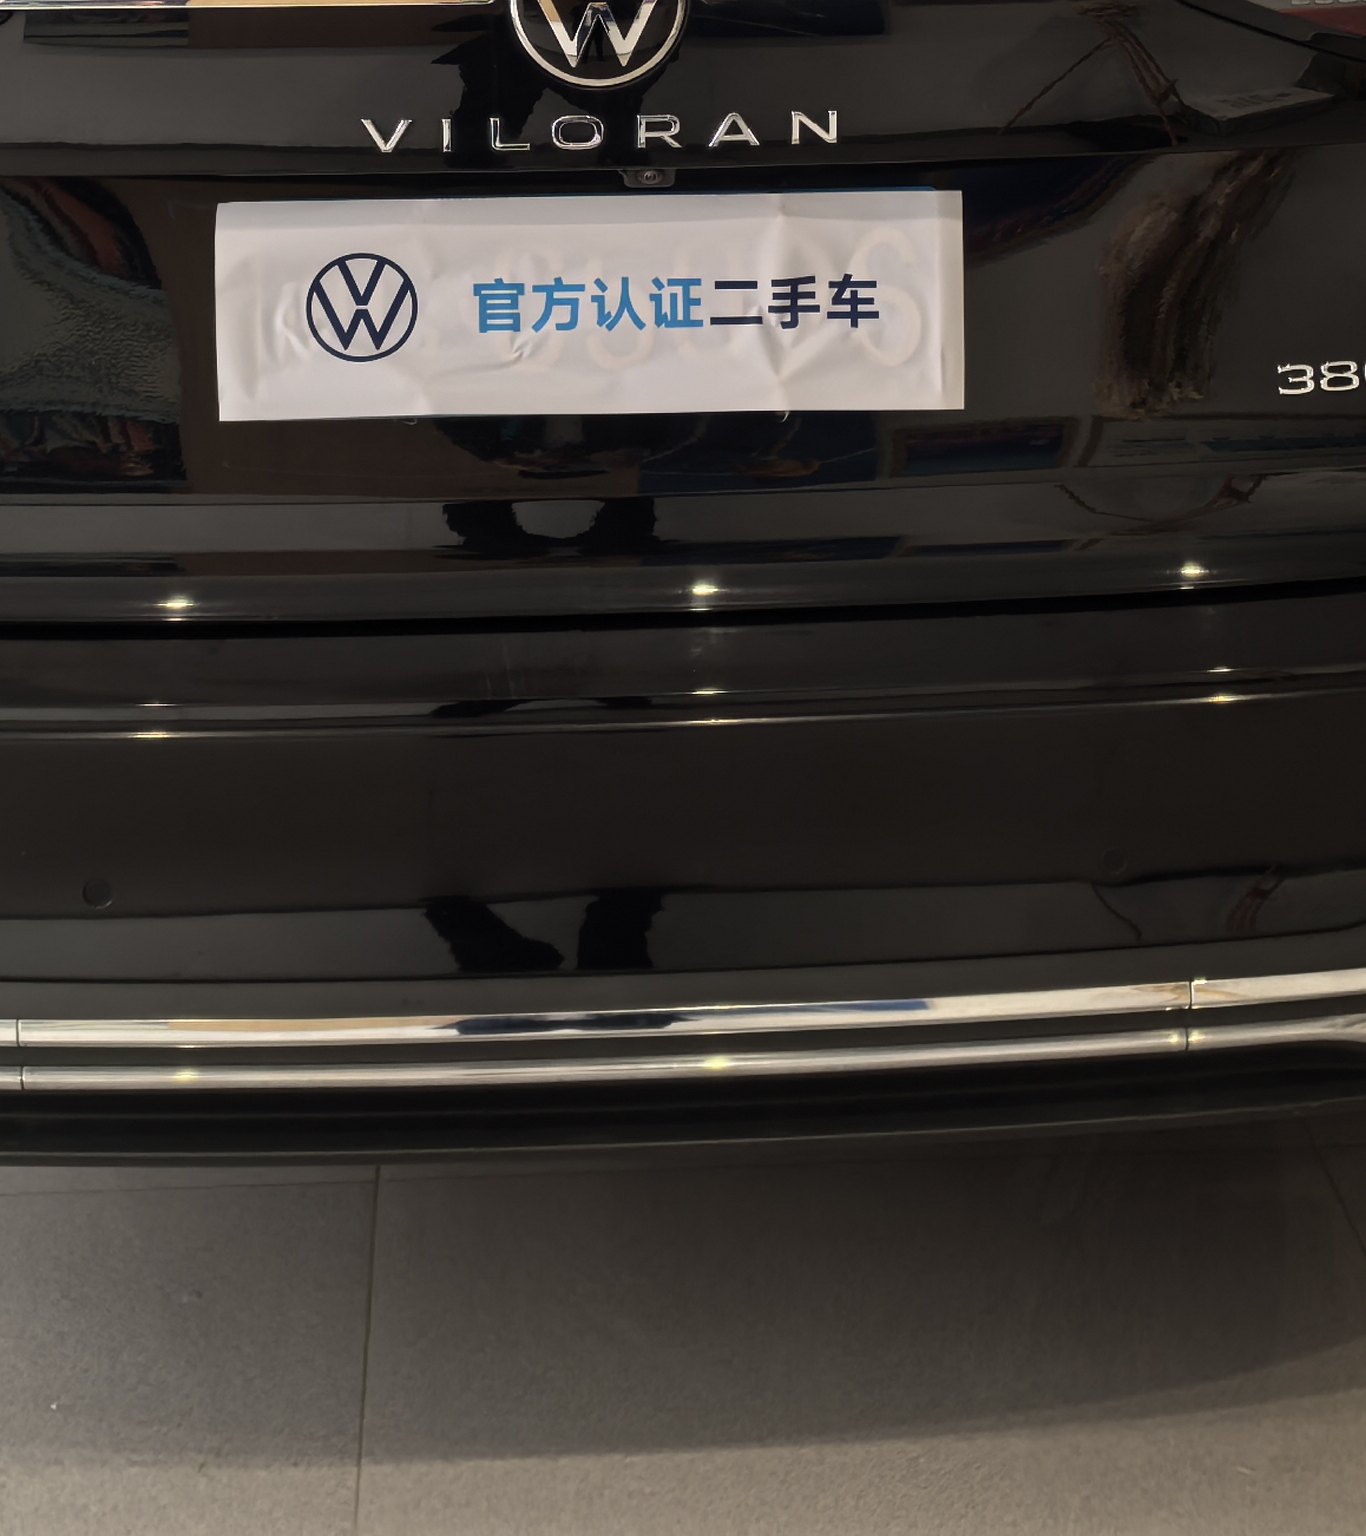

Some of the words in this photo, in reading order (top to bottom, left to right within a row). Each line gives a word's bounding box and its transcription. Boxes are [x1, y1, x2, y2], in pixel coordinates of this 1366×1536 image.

[360, 110, 840, 154] VILORAN
[306, 252, 418, 362] VW
[472, 274, 881, 334] 官方认证二手车
